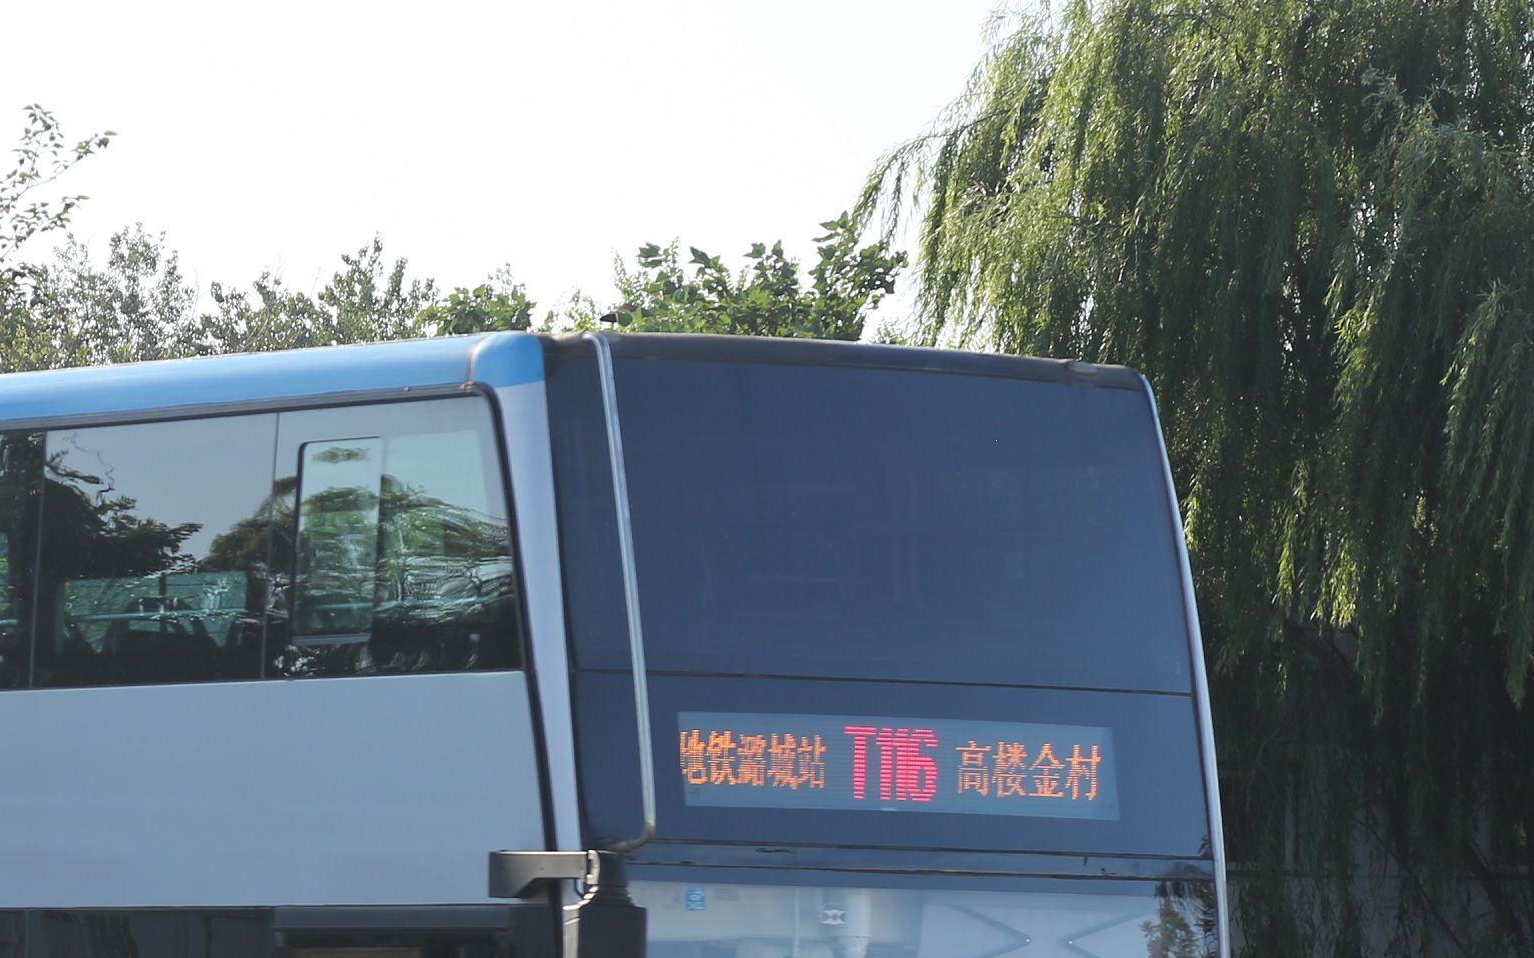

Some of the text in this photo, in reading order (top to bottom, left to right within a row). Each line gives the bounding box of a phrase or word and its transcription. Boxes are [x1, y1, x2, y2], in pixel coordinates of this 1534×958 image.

[844, 726, 939, 802] T116
[955, 740, 1102, 800] 高楼金村
